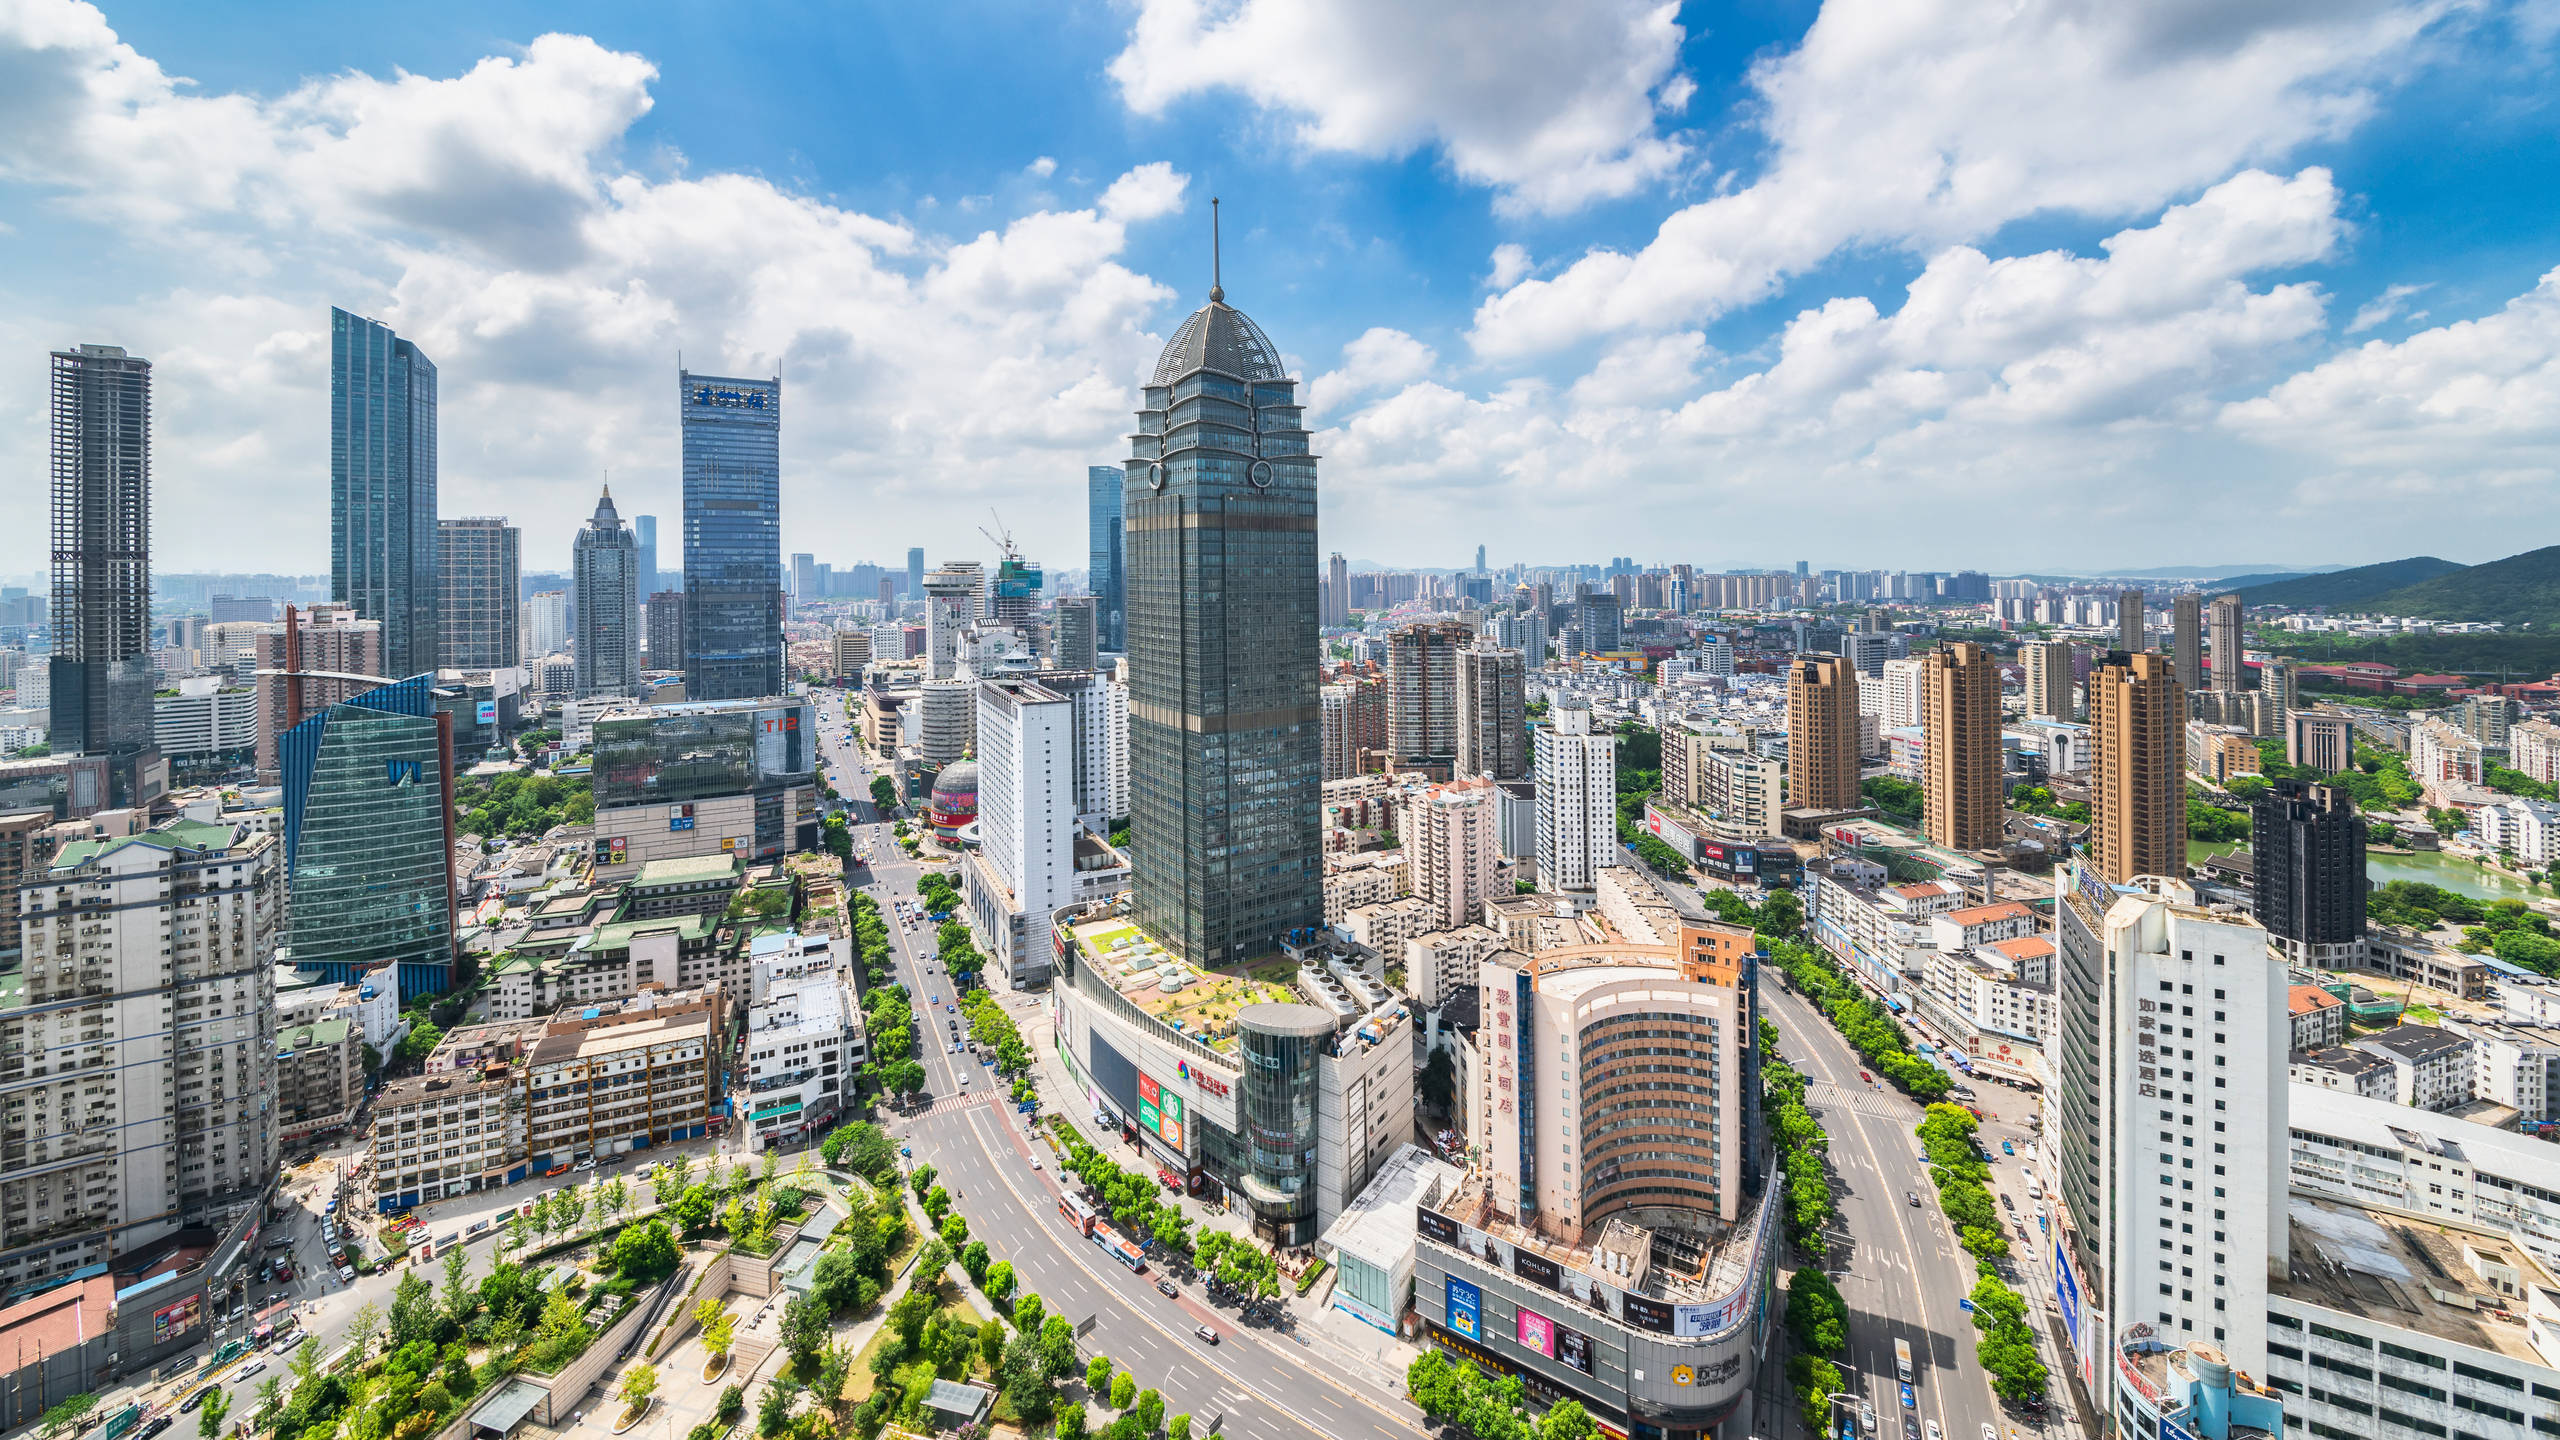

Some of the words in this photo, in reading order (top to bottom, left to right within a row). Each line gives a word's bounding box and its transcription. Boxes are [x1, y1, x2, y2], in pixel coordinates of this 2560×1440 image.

[2138, 998, 2157, 1098] 如家精选酒店
[1987, 1051, 2024, 1067] 红梅广场
[1521, 1258, 1551, 1276] KOHLER
[1696, 1368, 1741, 1388] suning.com
